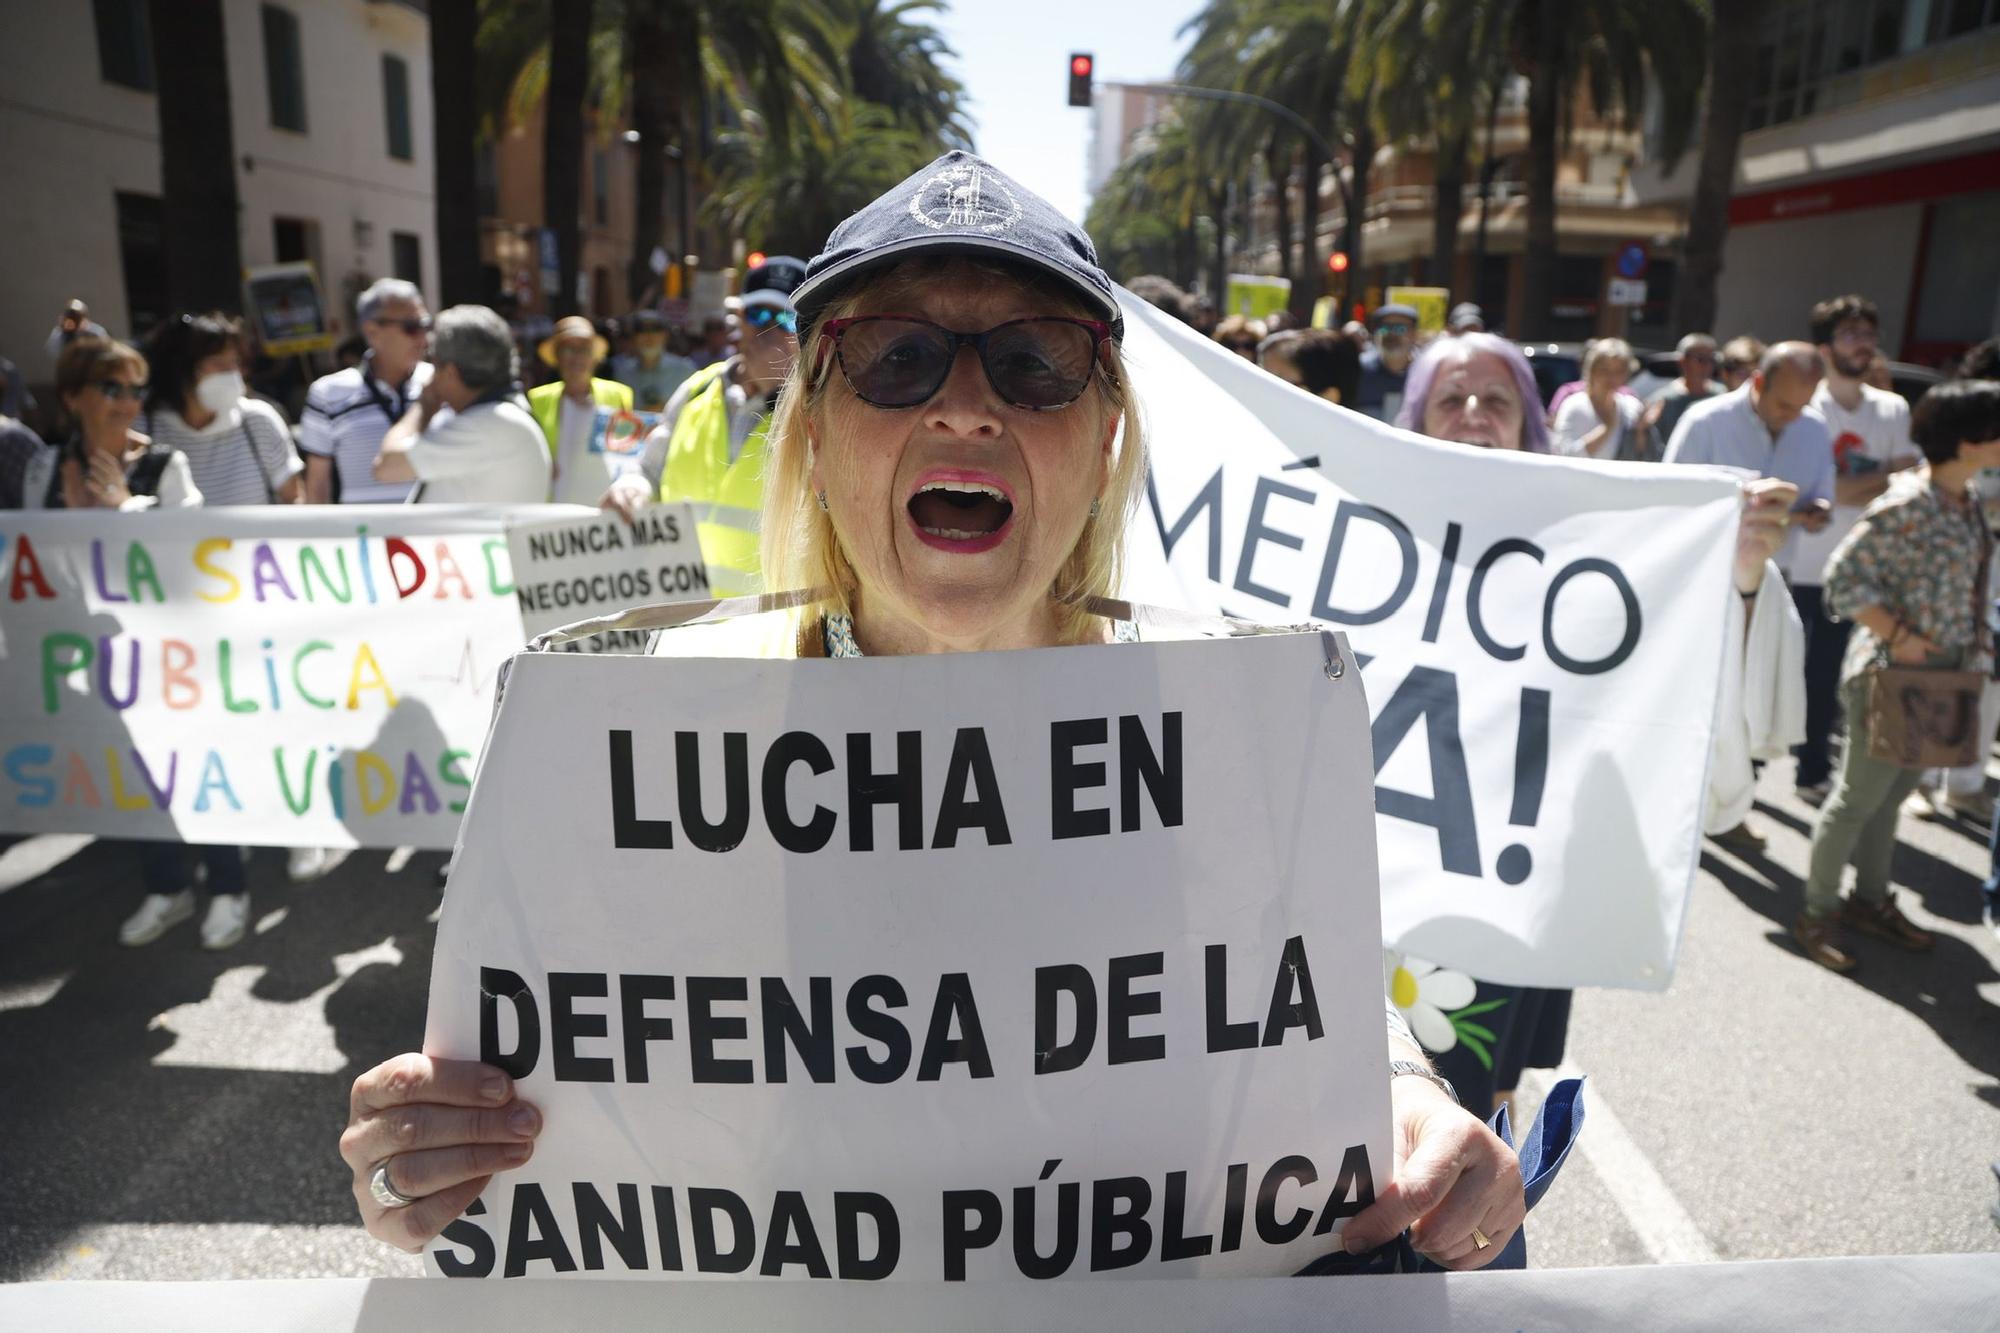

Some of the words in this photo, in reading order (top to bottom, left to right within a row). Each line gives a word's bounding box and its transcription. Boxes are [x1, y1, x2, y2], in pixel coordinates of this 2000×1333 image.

[91, 539, 165, 604] LA
[518, 568, 651, 616] NEGOCIOS
[658, 561, 710, 595] CON
[529, 523, 623, 562] NUNCA
[1148, 456, 1642, 676] MÉDICO
[4, 744, 243, 812] SALVA
[609, 728, 1012, 853] LUCHA
[1051, 711, 1184, 840] EN
[480, 966, 995, 1084] DEFENSA
[1035, 952, 1166, 1076] DE
[1205, 935, 1325, 1054] LA
[433, 1181, 901, 1281] SANIDAD
[943, 1144, 1376, 1282] PÚBLICA
